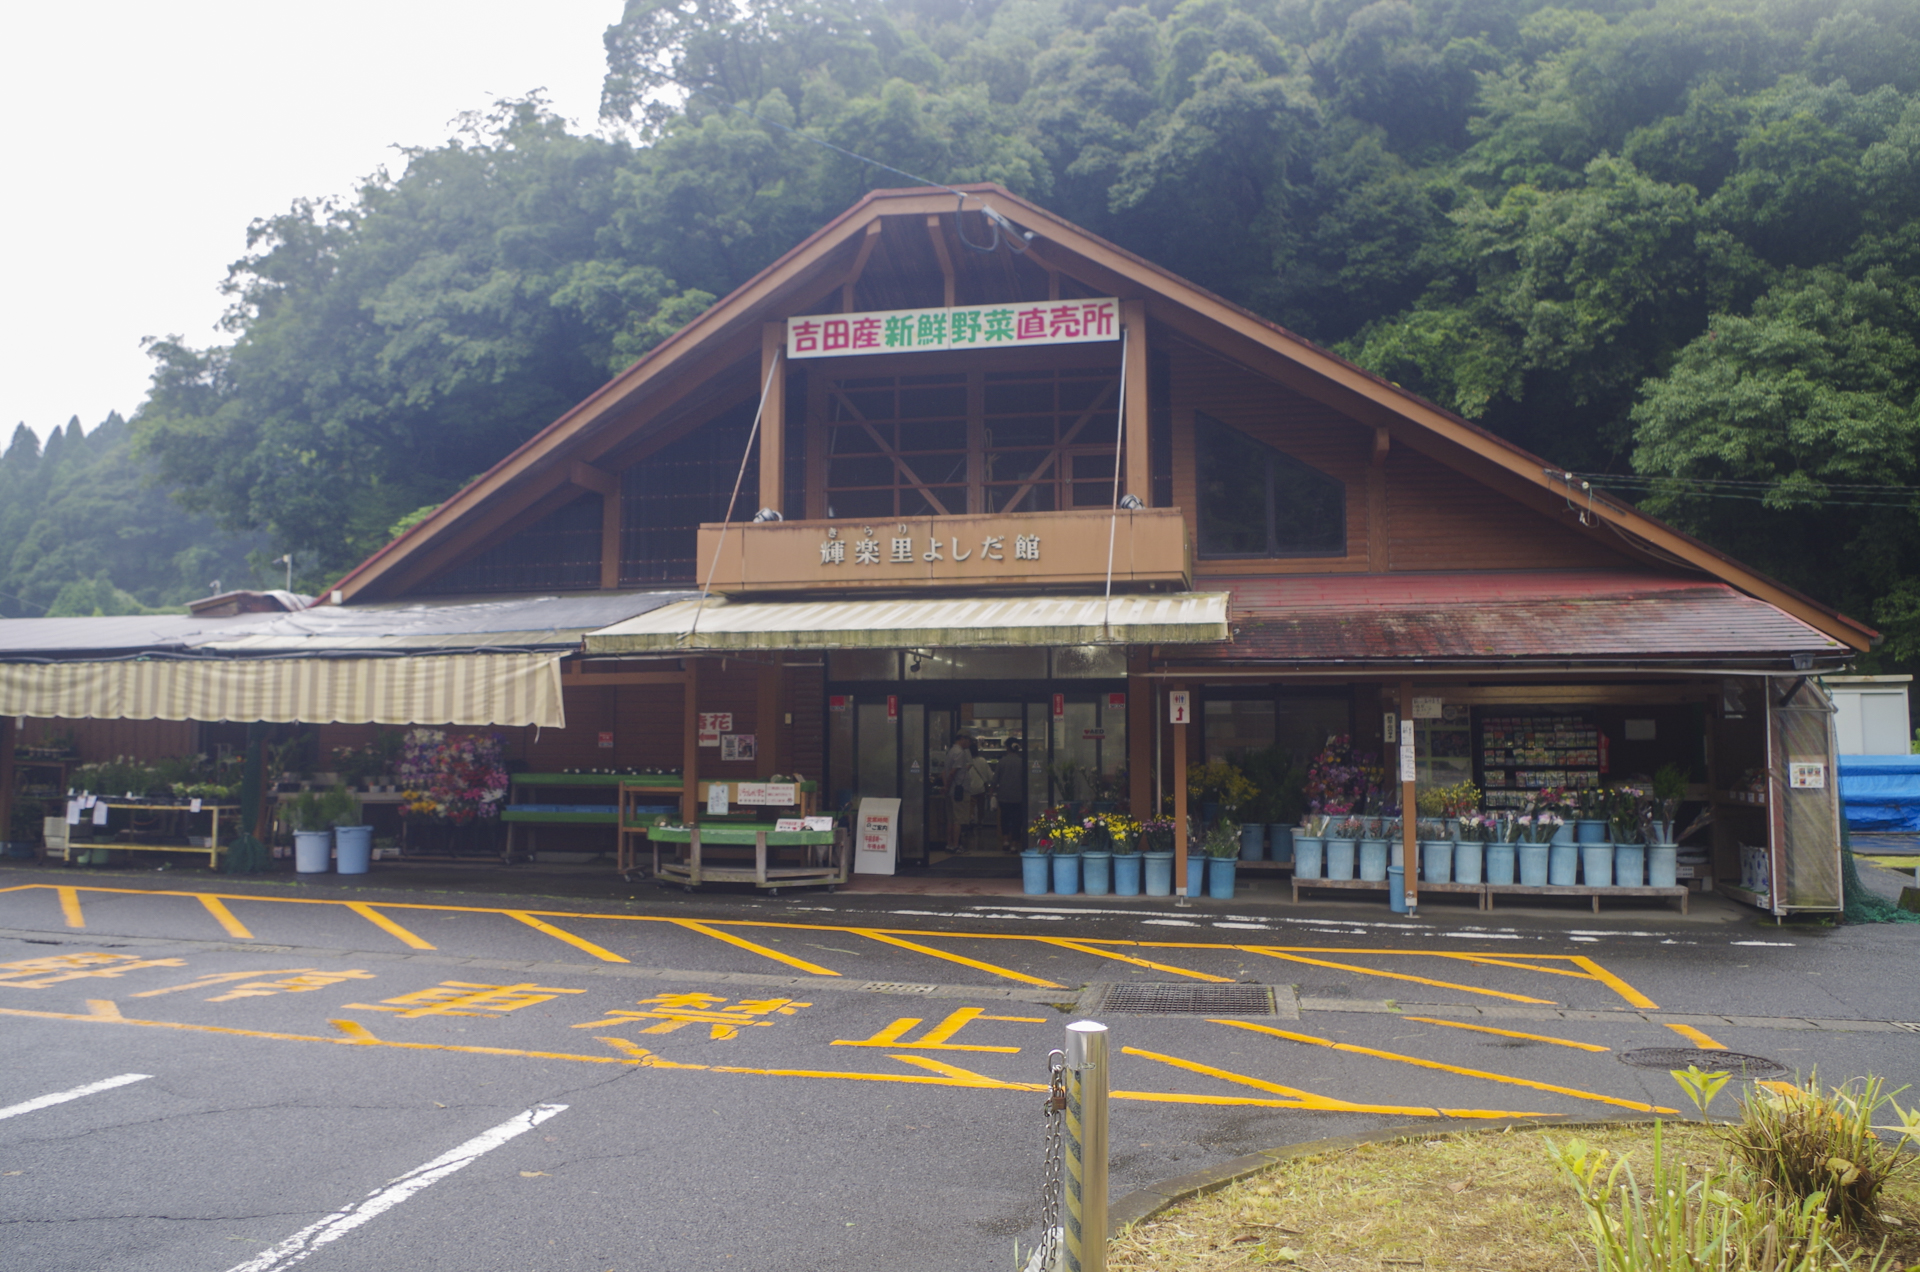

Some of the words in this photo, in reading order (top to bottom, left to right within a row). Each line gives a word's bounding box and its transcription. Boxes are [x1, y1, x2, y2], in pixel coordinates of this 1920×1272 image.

[792, 302, 1113, 352] 吉田産新鮮野菜直売所
[820, 534, 1040, 565] 輝楽里よしだ館
